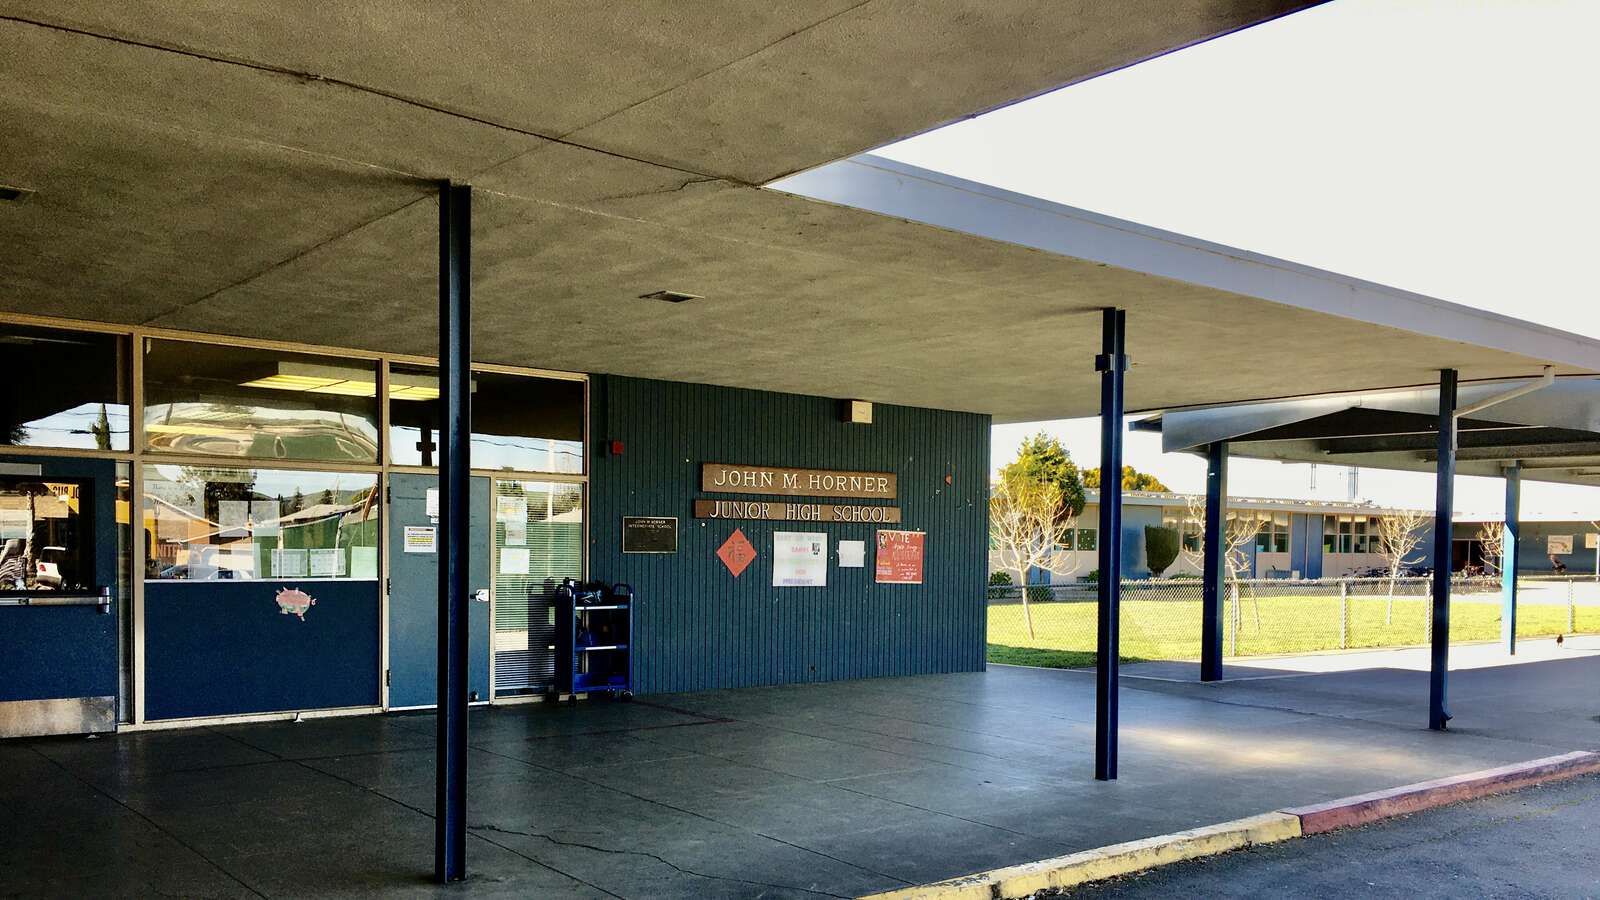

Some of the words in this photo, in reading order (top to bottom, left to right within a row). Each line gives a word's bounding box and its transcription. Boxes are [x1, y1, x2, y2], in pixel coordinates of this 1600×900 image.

[714, 470, 774, 487] JOHN
[783, 474, 802, 489] M.
[809, 475, 888, 493] HORNER
[709, 501, 770, 518] JUNIOR
[786, 503, 821, 521] HIGH
[833, 505, 892, 522] SCHOOL
